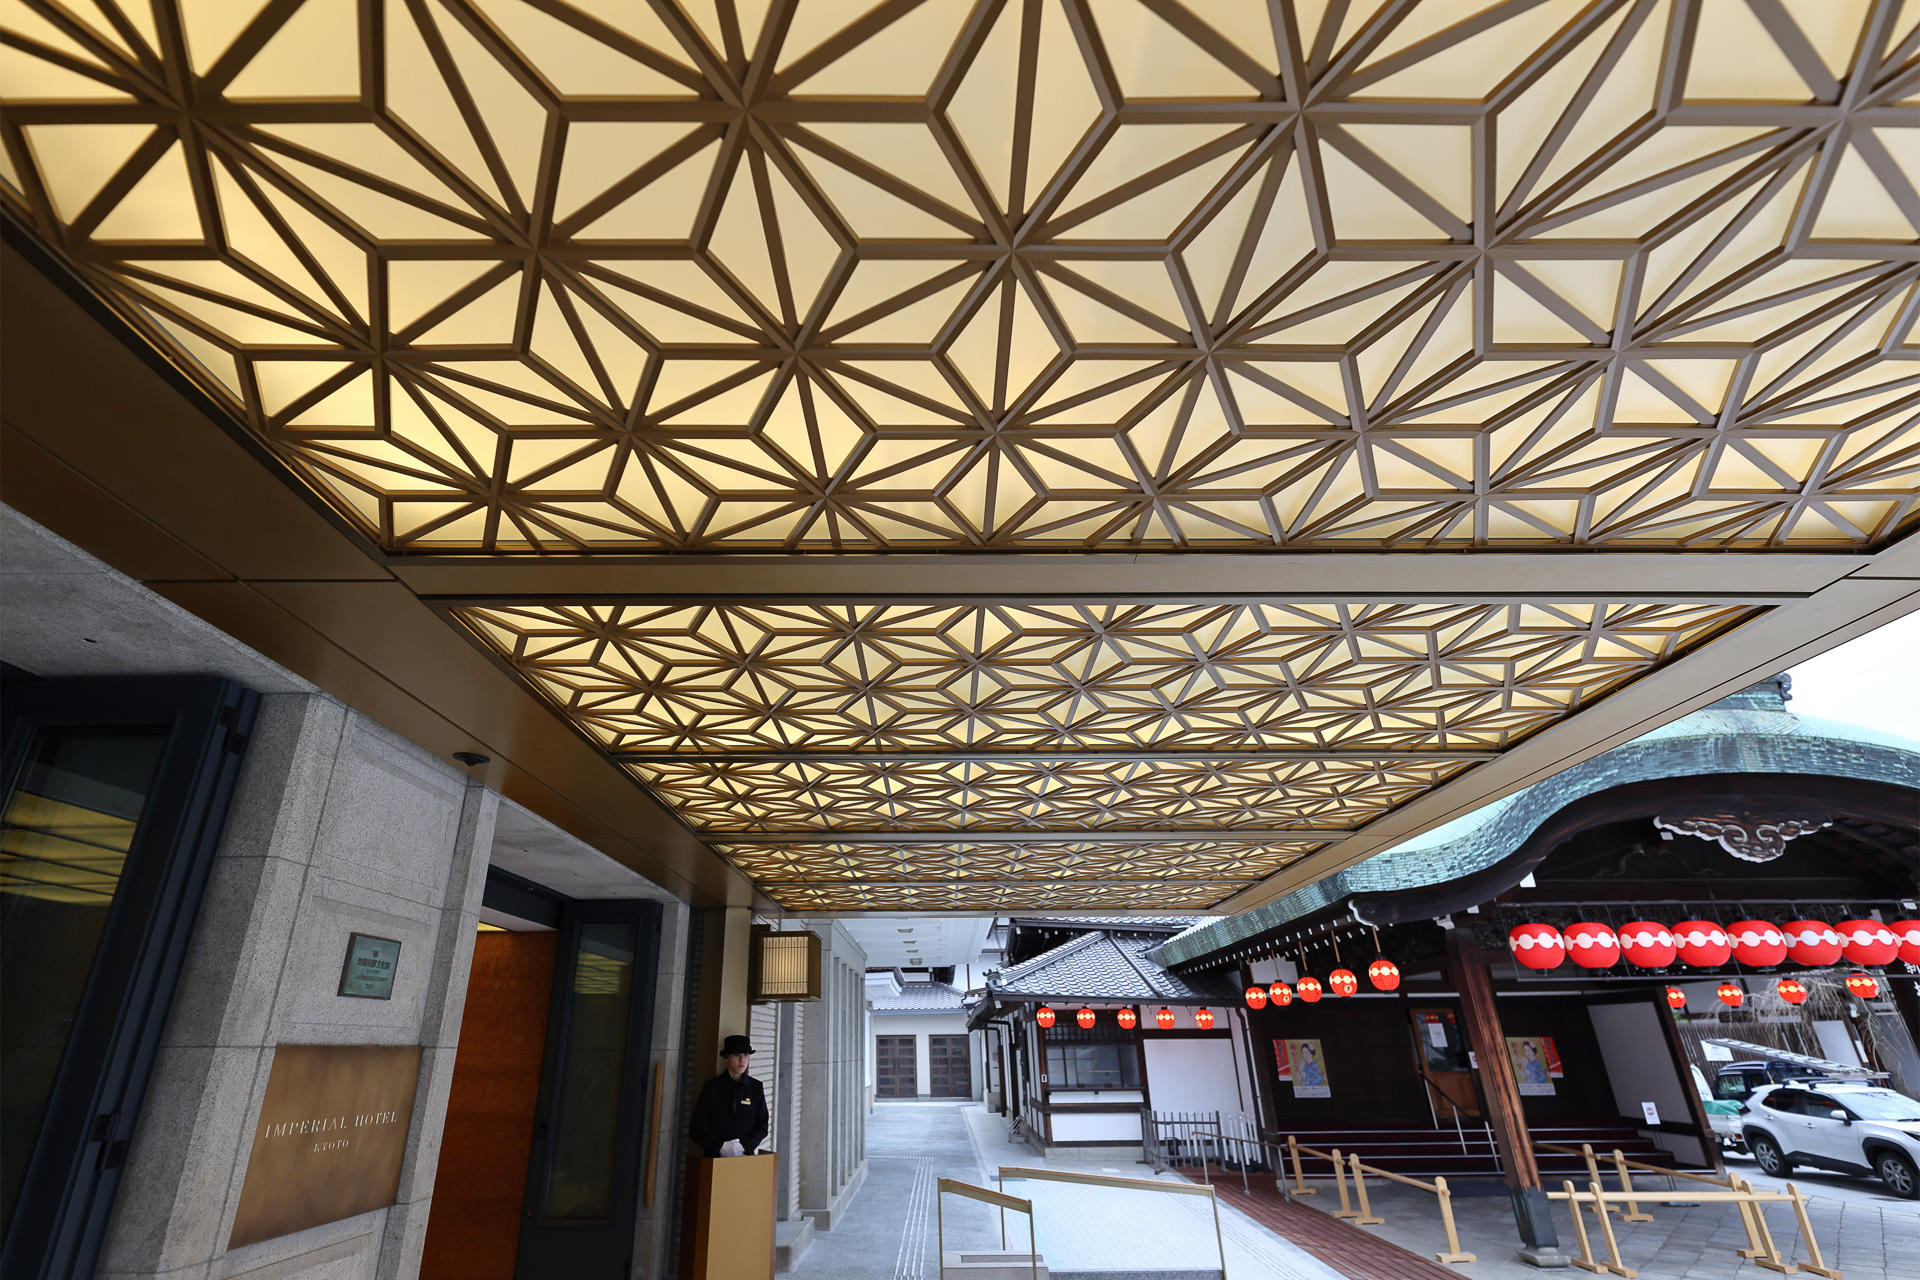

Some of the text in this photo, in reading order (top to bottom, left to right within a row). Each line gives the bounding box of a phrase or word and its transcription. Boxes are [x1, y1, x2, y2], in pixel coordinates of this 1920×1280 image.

[265, 1111, 397, 1138] IMPERIAL HOTEL
[314, 1140, 349, 1152] KYOTO
